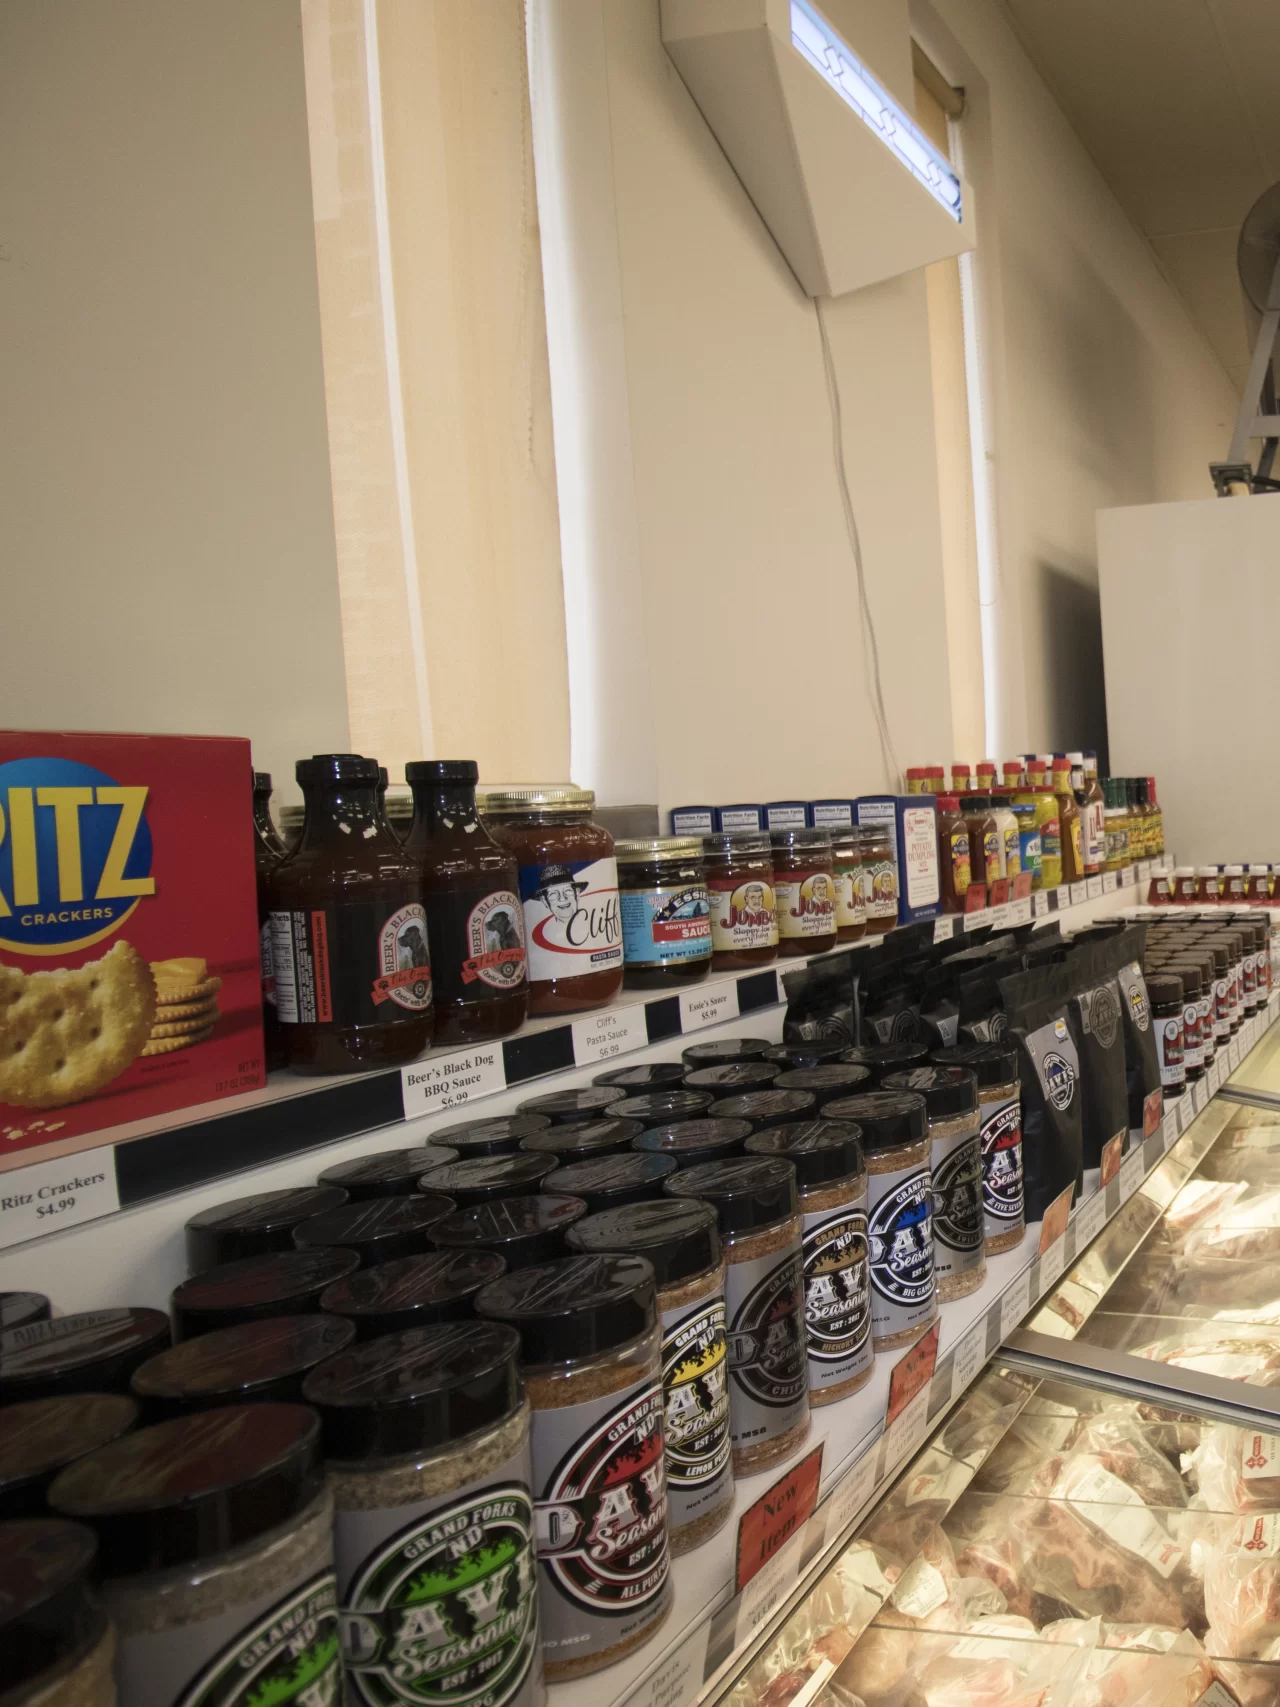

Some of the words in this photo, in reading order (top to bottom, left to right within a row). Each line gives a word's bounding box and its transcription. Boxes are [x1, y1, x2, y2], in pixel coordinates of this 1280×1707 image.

[20, 907, 113, 926] CRACKERS
[472, 916, 484, 956] BEER'S
[383, 931, 395, 974] BEER'S
[660, 951, 675, 959] NET
[688, 1000, 710, 1013] Essie's
[710, 994, 728, 1006] Sauce
[596, 1015, 617, 1029] Cliff's
[701, 1009, 717, 1021] $5.99
[586, 1035, 607, 1046] Pasta
[607, 1028, 628, 1042] Sauce
[599, 1044, 620, 1058] $6.99
[406, 1068, 441, 1087] Beer's
[443, 1059, 472, 1076] Black
[474, 1054, 494, 1067] Dog
[424, 1081, 449, 1098] BBQ
[452, 1074, 482, 1090] Sauce
[1, 1193, 34, 1212] Ritz
[37, 1172, 106, 1200] Crackers
[896, 1181, 923, 1203] GRAND
[913, 1189, 926, 1204] ND
[36, 1196, 77, 1220] $4.99
[993, 1201, 1008, 1211] FIVE
[815, 1224, 846, 1246] GRAND
[835, 1232, 852, 1251] ND
[902, 1286, 916, 1298] BIG
[675, 1317, 707, 1348] GRAND
[829, 1318, 844, 1332] EST
[697, 1327, 716, 1350] ND
[821, 1336, 854, 1352] HICKORY
[821, 1370, 834, 1379] Net
[835, 1360, 857, 1377] Weight
[607, 1403, 649, 1443] GRAND
[636, 1413, 656, 1443] ND
[694, 1433, 709, 1452] EST
[741, 1426, 767, 1441] MSG
[685, 1456, 714, 1477] LEMON
[685, 1498, 702, 1511] Net
[763, 1485, 797, 1527] New
[403, 1514, 469, 1560] GRAND
[472, 1501, 517, 1525] FORKS
[760, 1513, 797, 1562] Item
[447, 1525, 484, 1560] ND
[628, 1550, 647, 1568] EST
[620, 1583, 642, 1600] ALL
[238, 1606, 307, 1669] GRAND
[288, 1616, 318, 1659] ND
[620, 1622, 637, 1636] Net
[392, 1602, 528, 1680] Seasoning
[561, 1633, 592, 1647] MSG
[441, 1671, 469, 1692] EST
[477, 1651, 503, 1675] 2017
